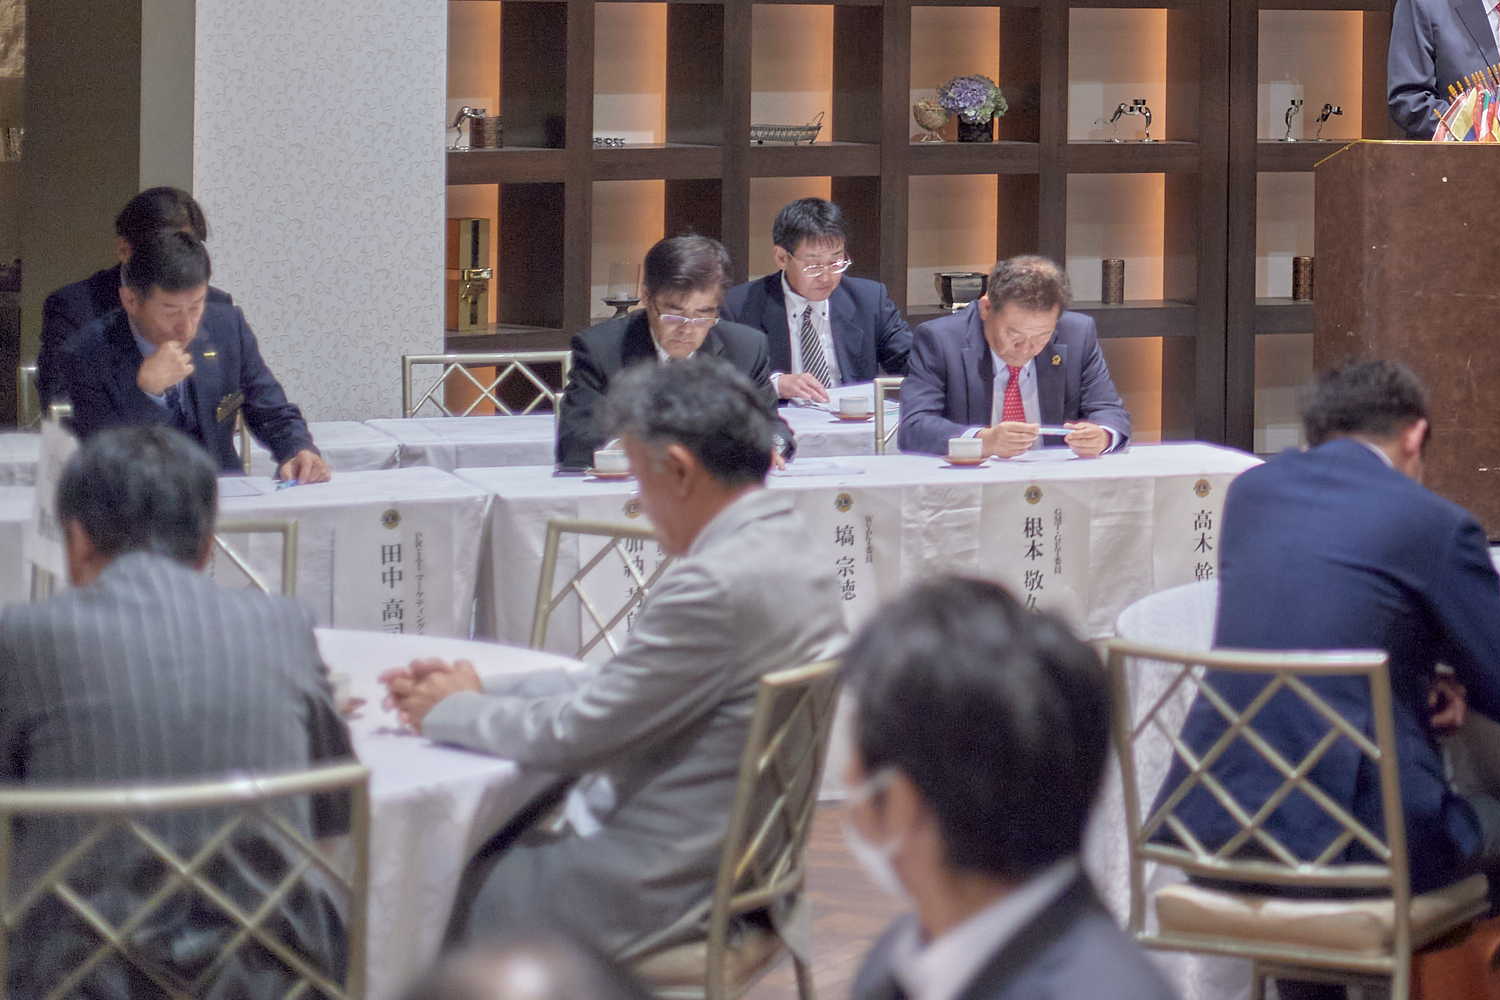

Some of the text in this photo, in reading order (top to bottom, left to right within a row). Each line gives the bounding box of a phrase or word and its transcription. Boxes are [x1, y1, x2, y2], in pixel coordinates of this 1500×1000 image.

[834, 524, 855, 547] 塙
[1023, 516, 1044, 561] 根本
[1193, 509, 1213, 554] 高木
[381, 543, 402, 589] 田中
